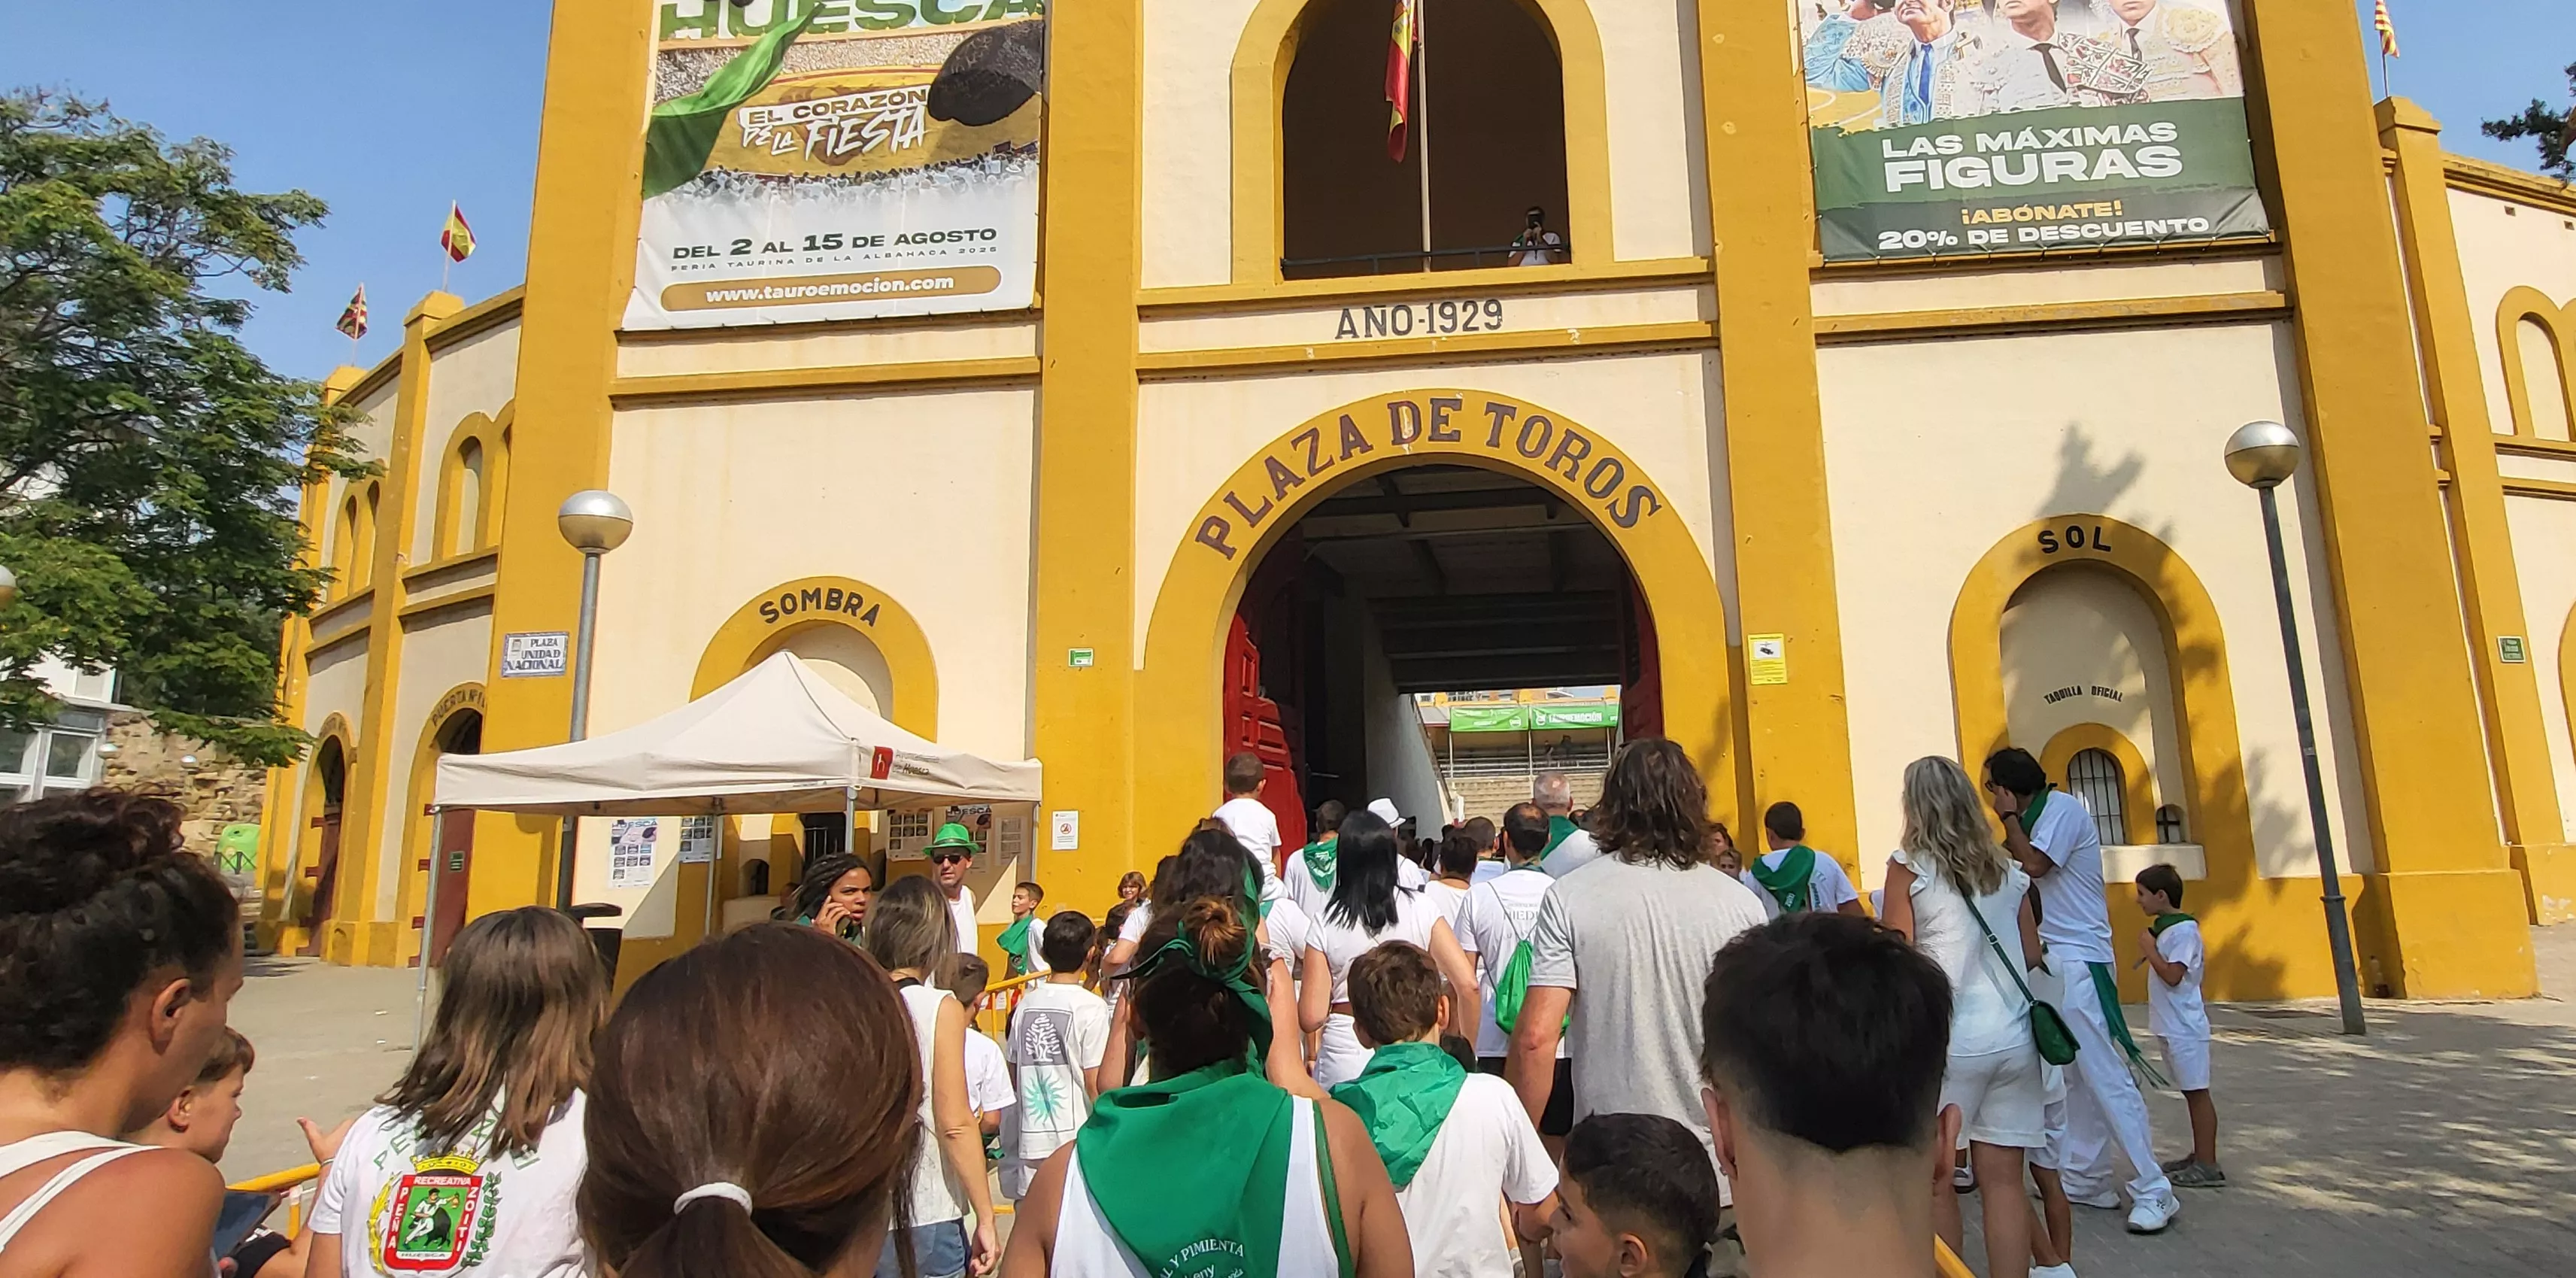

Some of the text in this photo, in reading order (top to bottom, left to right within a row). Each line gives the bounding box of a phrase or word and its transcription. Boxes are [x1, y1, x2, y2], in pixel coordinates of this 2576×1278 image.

[749, 89, 927, 124] EL CORAZÓN
[804, 105, 926, 162] FIESTA
[1882, 121, 2179, 158] LAS MÁXIMAS
[1883, 144, 2183, 193] FIGURAS
[1961, 200, 2124, 226] ¡ABÓNATE!
[673, 228, 997, 259] DEL 2 AL 15 DE AGOSTO
[1877, 217, 2210, 250] 20% DE DESCUENTO
[671, 263, 716, 272] FERIA
[728, 259, 794, 268] TAURINA
[863, 249, 947, 260] ALBAHACA
[706, 276, 954, 303] www.tauroemocion.com
[1196, 398, 1662, 560] PLAZA DE TOROS
[2037, 526, 2112, 554] SOL
[760, 587, 880, 627] SOMBRA
[521, 649, 561, 660] UNIDAD
[530, 638, 558, 647] PLAZA
[505, 659, 563, 670] NACIONAL
[2044, 685, 2123, 705] TAQUILLA OFICIAL
[413, 1176, 472, 1185] RECREATIVA
[387, 1186, 409, 1249] PEÑA
[457, 1186, 479, 1252] ZOITI
[1170, 1255, 1179, 1268] Y
[1180, 1238, 1244, 1261] PIMIENTA
